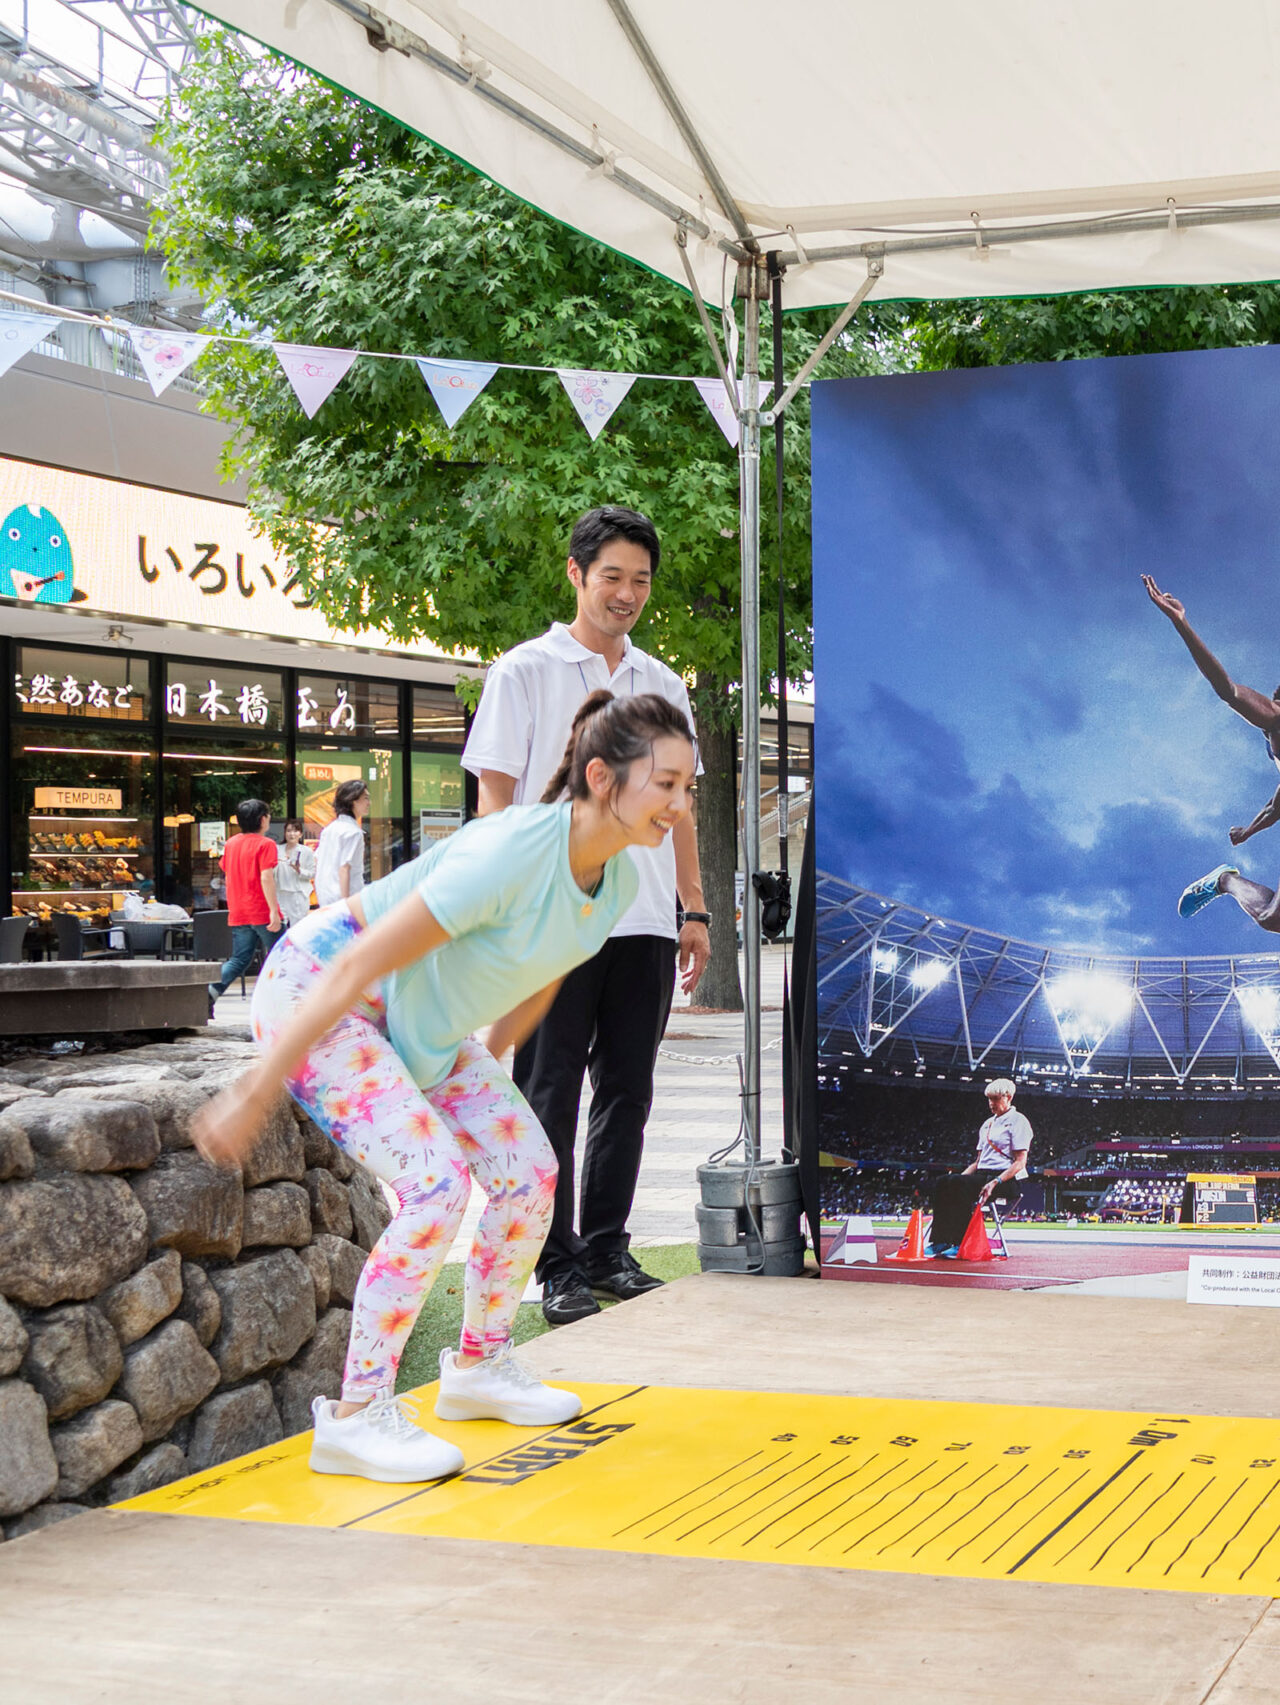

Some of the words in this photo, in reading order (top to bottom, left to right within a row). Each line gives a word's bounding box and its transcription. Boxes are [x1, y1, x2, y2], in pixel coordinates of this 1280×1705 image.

[57, 791, 114, 805] TEMPURA
[830, 1435, 860, 1445] 50
[889, 1435, 919, 1447] 60
[460, 1421, 636, 1486] START
[1190, 1454, 1217, 1465] 10
[1249, 1458, 1277, 1468] 20
